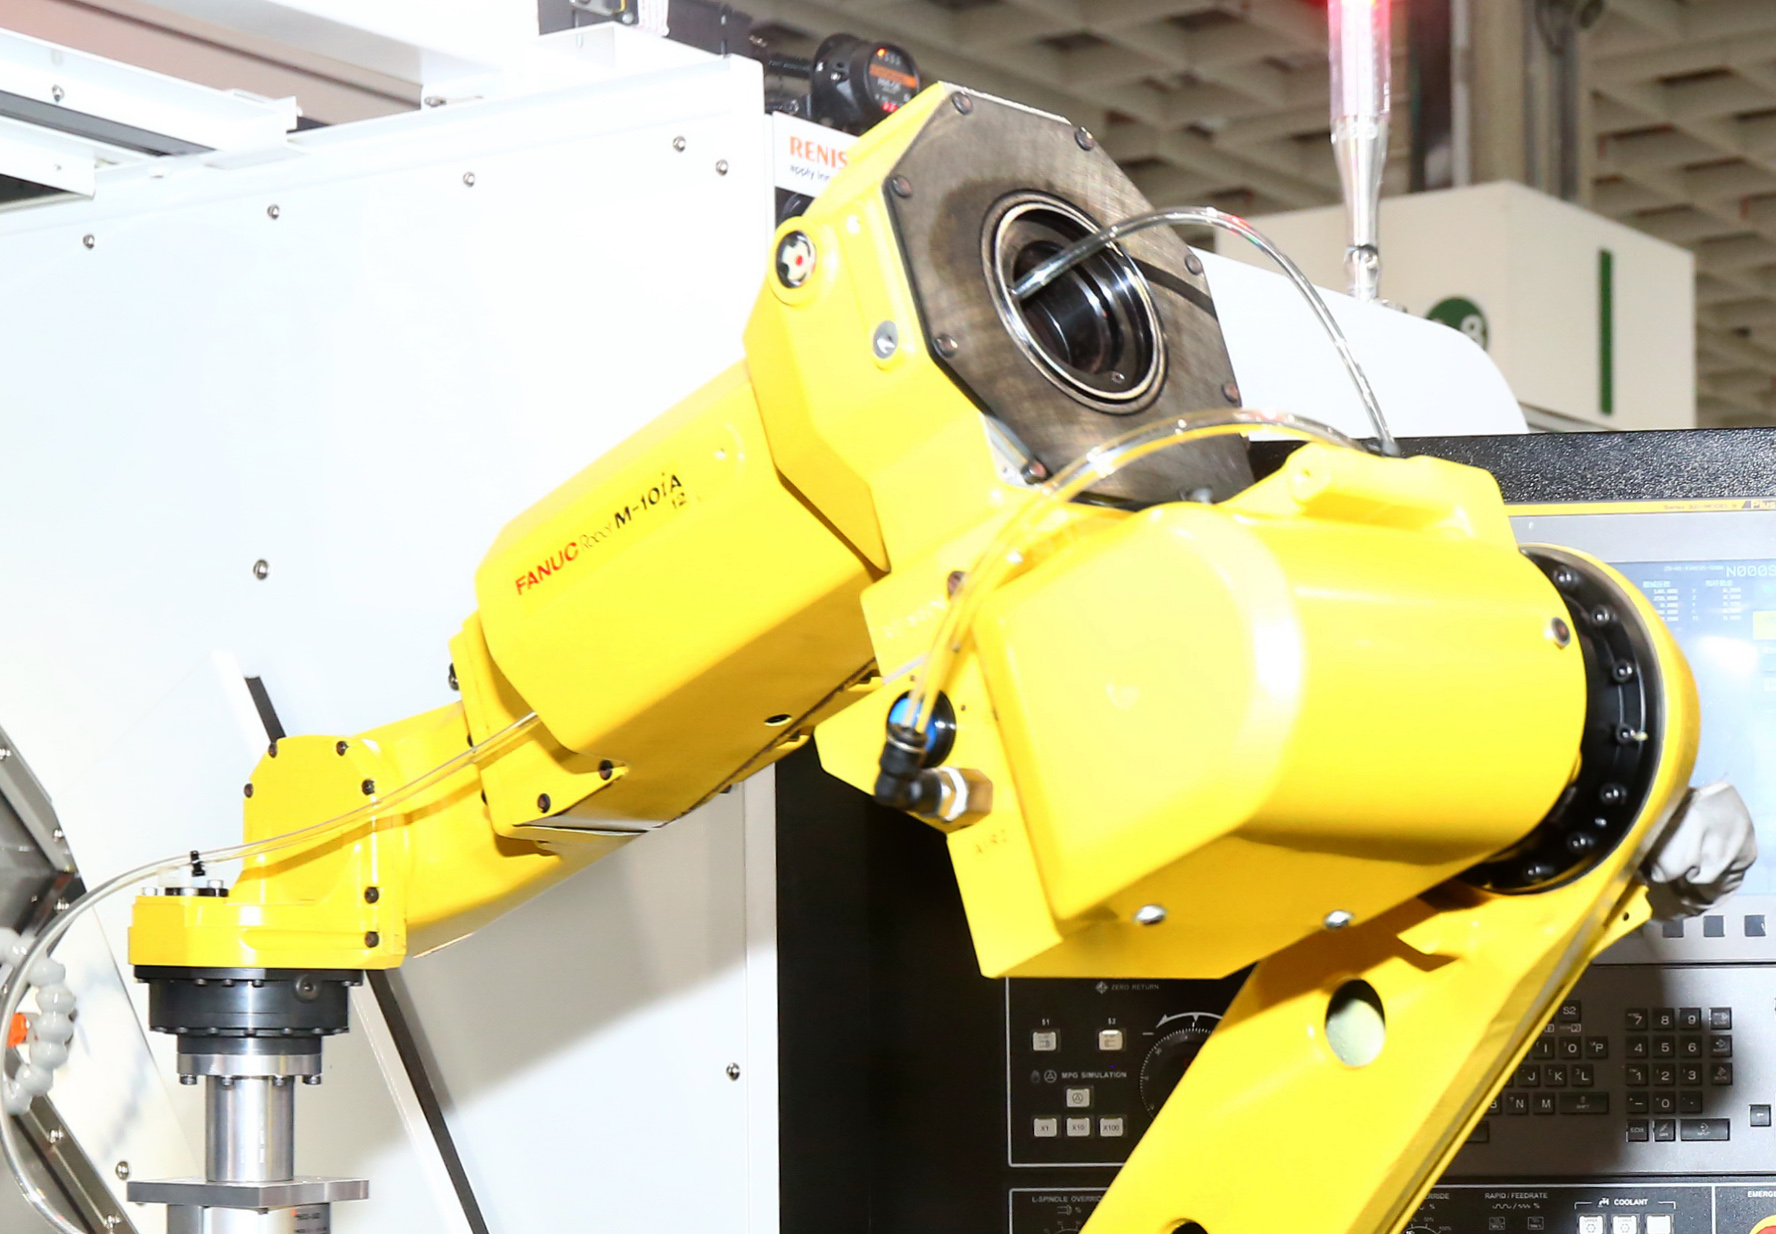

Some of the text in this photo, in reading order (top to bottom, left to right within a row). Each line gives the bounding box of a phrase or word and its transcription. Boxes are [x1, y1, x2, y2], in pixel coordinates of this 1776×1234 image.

[515, 542, 579, 595] FANUC
[1563, 1006, 1577, 1015] S2
[1635, 1015, 1643, 1025] 7
[1661, 1015, 1670, 1025] 8
[1688, 1014, 1696, 1025] 9
[1062, 1071, 1127, 1079] MPG SIMULATION
[1485, 1192, 1505, 1200] RAPID
[1614, 1198, 1648, 1206] COOLANT
